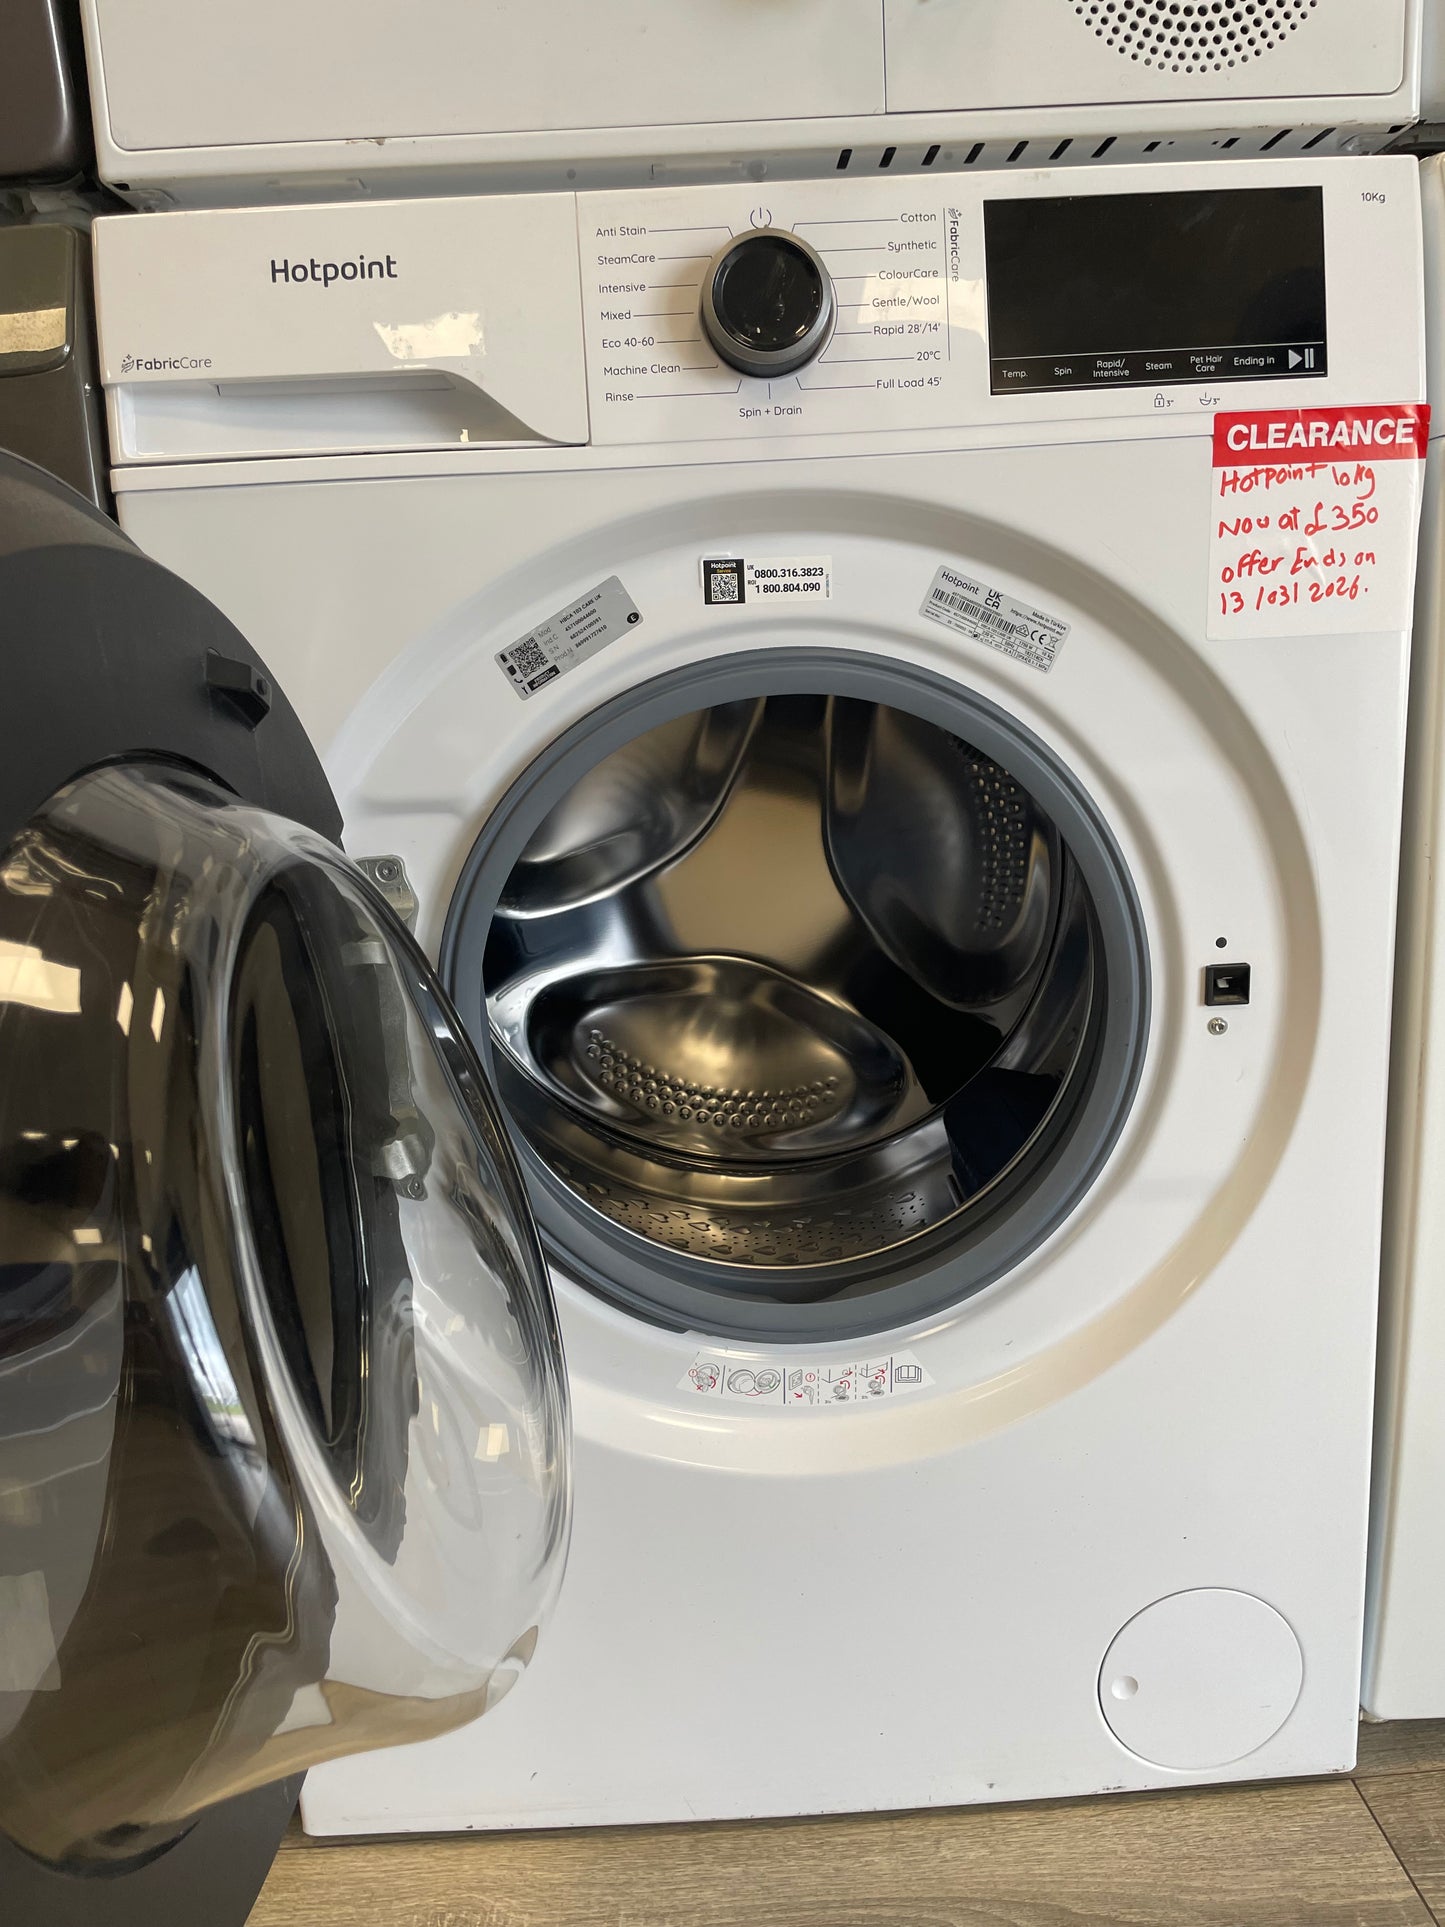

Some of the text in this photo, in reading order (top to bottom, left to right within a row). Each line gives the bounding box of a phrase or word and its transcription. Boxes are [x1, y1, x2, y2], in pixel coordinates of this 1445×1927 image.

[1361, 192, 1386, 204] 10Kg
[900, 212, 936, 223] Cotton
[596, 225, 646, 237] Anti Stain
[887, 239, 937, 252] Synthetic
[950, 221, 960, 282] FabricCare
[598, 253, 656, 265] SteamCare
[270, 254, 398, 288] Hotpoint
[878, 268, 938, 280] ColourCare
[599, 282, 646, 293] Intensive
[872, 295, 940, 308] Gentle/Wool
[601, 310, 631, 321] Mixed
[873, 324, 905, 337] Rapid
[602, 336, 655, 349] Eco 40-60
[136, 356, 212, 371] FabricCare
[1096, 359, 1126, 370] Rapid/
[1190, 353, 1222, 364] Pet Hair
[1233, 354, 1275, 367] Ending in
[604, 363, 681, 376] Machine Clean
[1054, 365, 1072, 377] Spin
[1145, 361, 1173, 371] Steam
[1195, 363, 1215, 373] Care
[1002, 369, 1028, 380] Temp.
[1093, 367, 1130, 378] Intensive
[876, 379, 895, 389] Full
[898, 378, 925, 388] Load
[605, 391, 634, 403] Rinse
[739, 407, 762, 419] Spin
[774, 405, 802, 416] Drain
[1227, 418, 1415, 451] CLEARANCE
[1278, 506, 1300, 531] at
[1304, 501, 1379, 537] £350
[1354, 551, 1376, 566] on
[754, 567, 824, 579] 0800.316.3823
[763, 582, 820, 593] 800.804.090
[940, 571, 980, 596] Hotpoint
[987, 589, 1004, 601] UK
[573, 606, 582, 615] 103
[581, 598, 595, 609] CARE
[983, 597, 1000, 609] CA
[1031, 611, 1044, 620] Made
[1049, 619, 1066, 631] Türkiye
